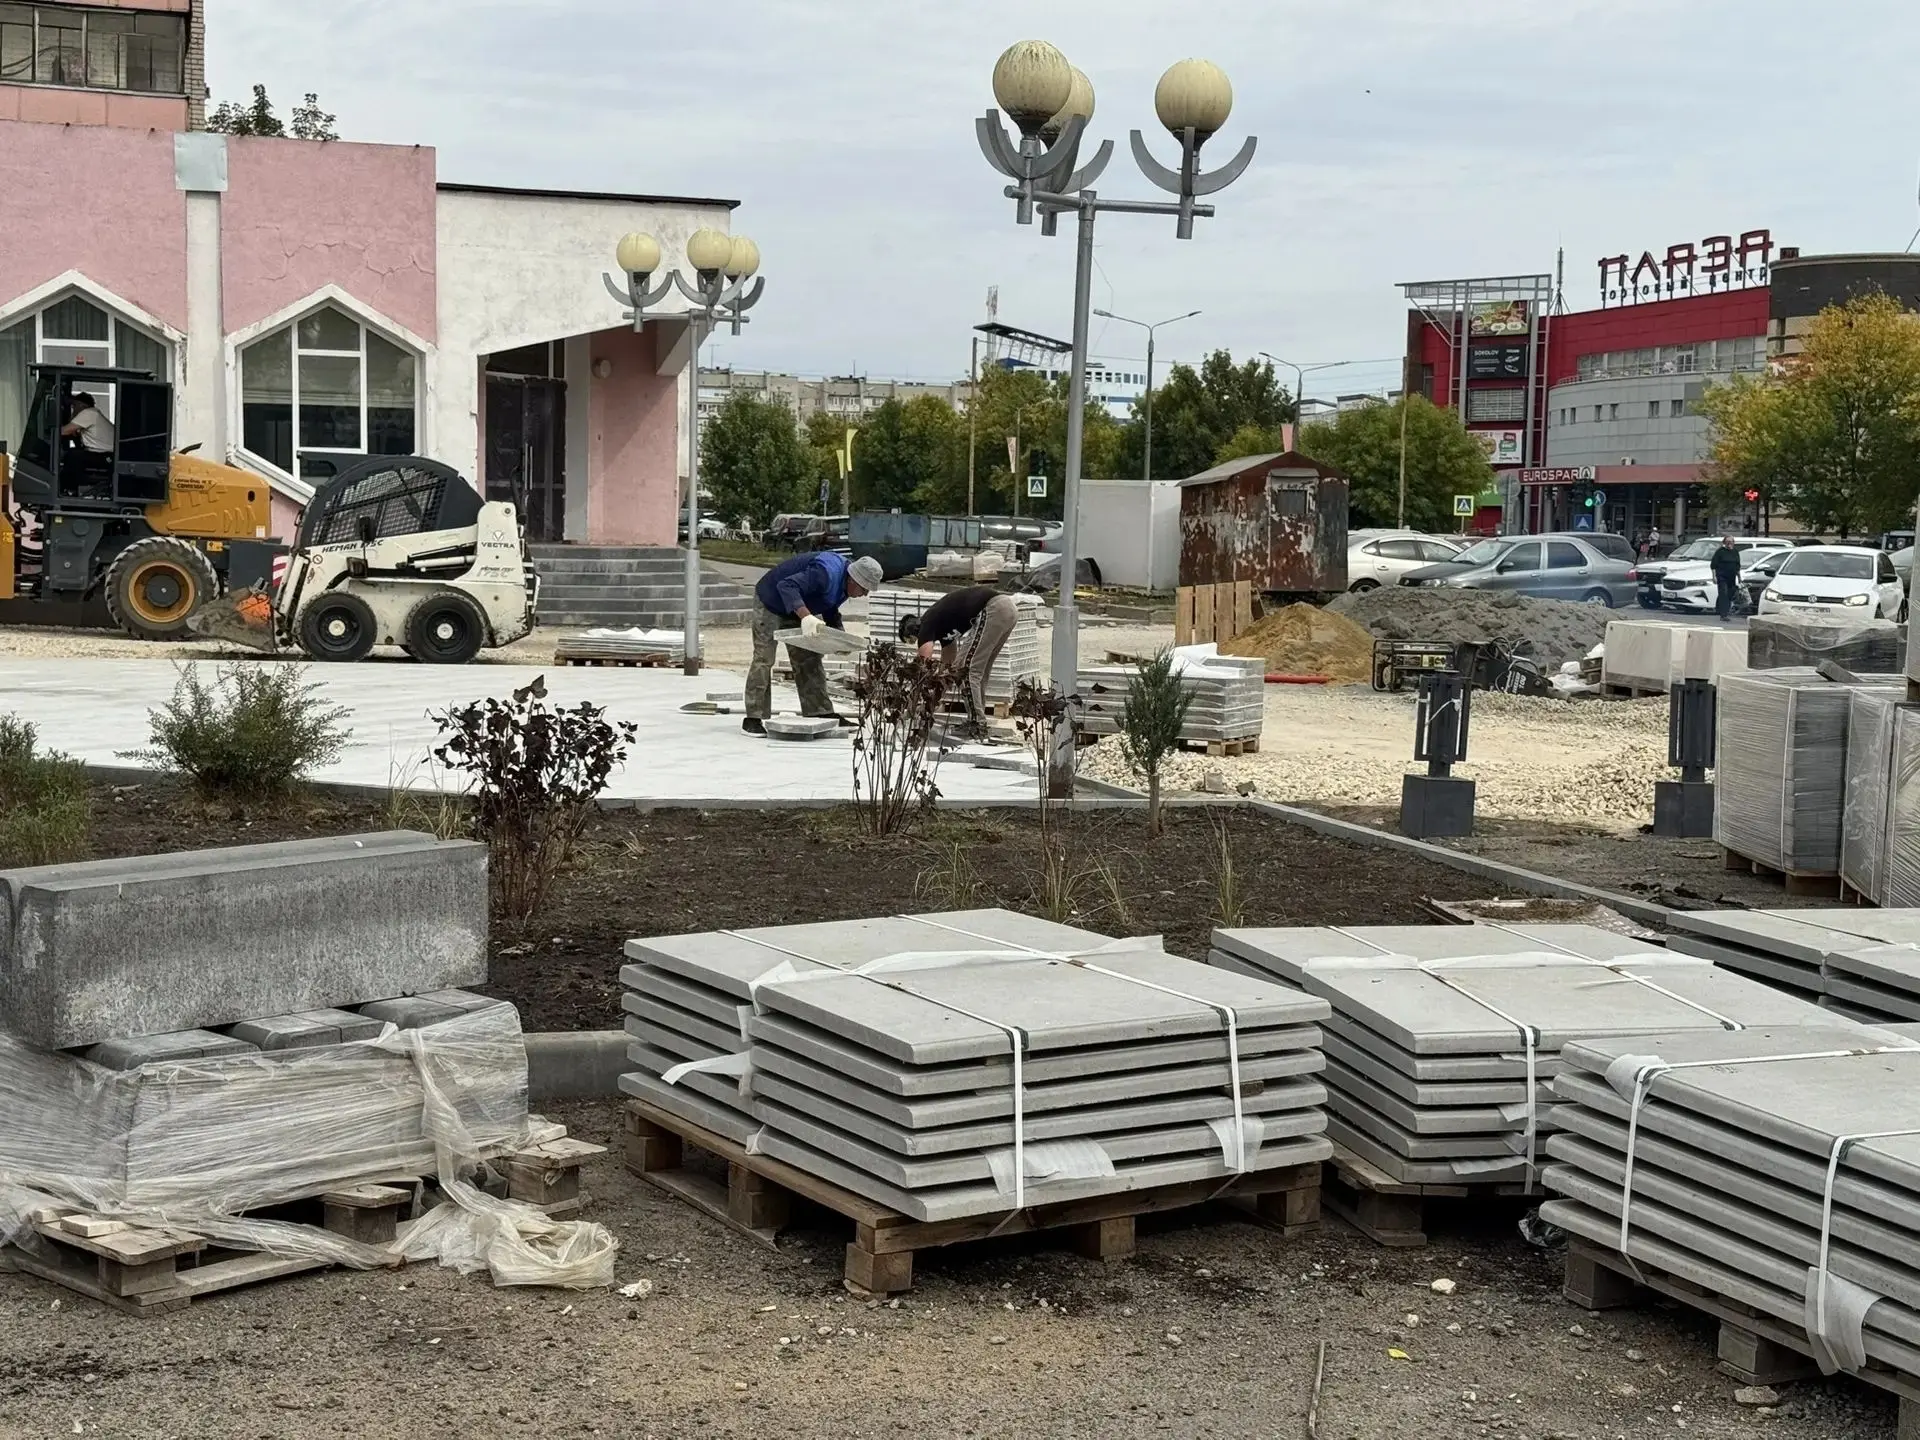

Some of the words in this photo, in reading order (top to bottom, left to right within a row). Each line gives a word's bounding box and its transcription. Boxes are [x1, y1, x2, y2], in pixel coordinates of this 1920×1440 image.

[1598, 229, 1774, 289] ПЛАЗА
[1523, 469, 1581, 482] EUROSPAR
[322, 542, 357, 554] HEMAN
[481, 541, 515, 549] VECTRA
